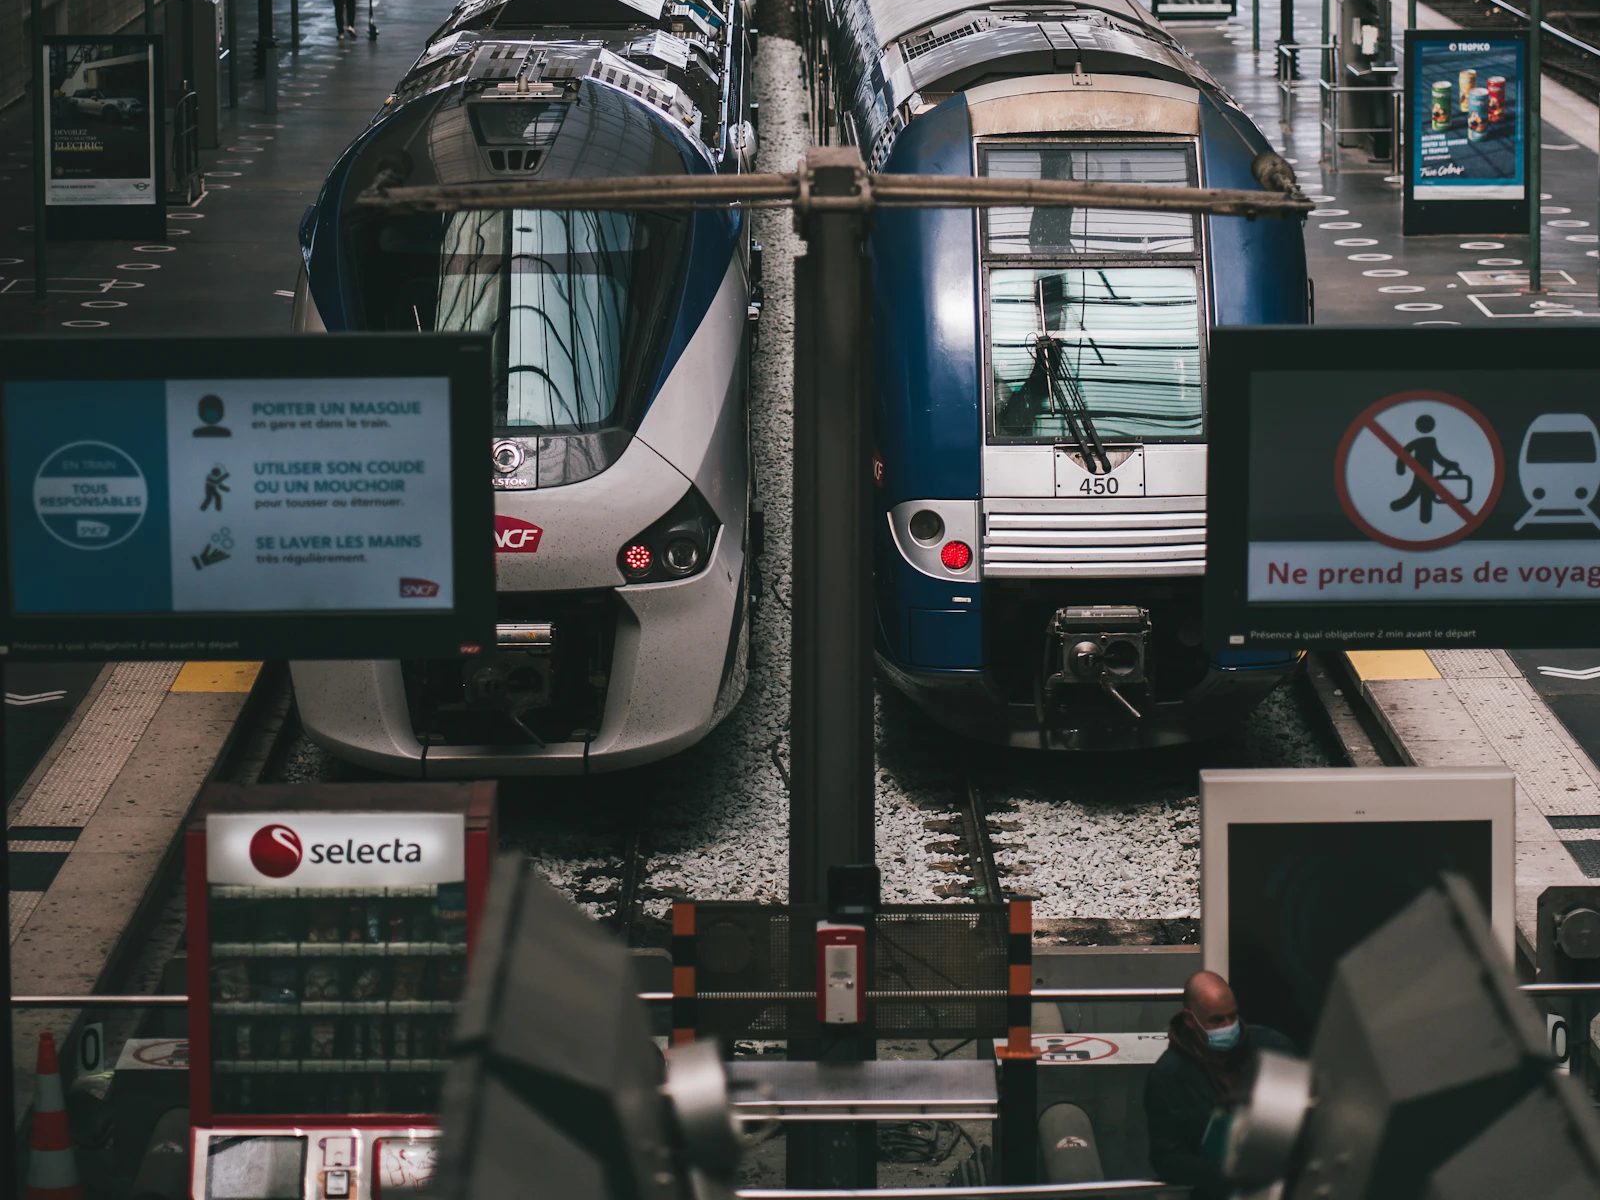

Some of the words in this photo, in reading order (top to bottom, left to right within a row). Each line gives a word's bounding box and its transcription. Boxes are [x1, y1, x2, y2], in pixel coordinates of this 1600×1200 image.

[1458, 43, 1490, 51] TROPICO
[251, 402, 315, 415] PORTER
[320, 402, 345, 415] UN
[350, 401, 422, 415] MASQUE
[251, 420, 266, 429] en
[269, 420, 296, 432] gare
[300, 418, 312, 429] et
[315, 418, 343, 429] dans
[346, 417, 357, 428] le
[360, 417, 391, 428] train.
[61, 460, 79, 470] EN
[253, 462, 323, 475] UTILISER
[326, 461, 363, 474] SON
[366, 460, 425, 474] COUDE
[71, 484, 108, 494] TOUS
[254, 480, 280, 493] OU
[284, 480, 309, 493] UN
[314, 479, 406, 493] MOUCHOIR
[492, 478, 527, 486] LSTOM
[1079, 477, 1119, 494] 450
[40, 496, 142, 507] RESPONSABLES
[254, 499, 282, 510] pour
[286, 498, 328, 508] tousser
[331, 499, 347, 507] ou
[256, 536, 275, 549] SE
[279, 536, 332, 549] LAVER
[336, 536, 364, 548] LES
[368, 535, 422, 548] MAINS
[494, 529, 538, 548] NCF
[256, 553, 279, 564] très
[1267, 562, 1308, 585] Ne
[1318, 561, 1403, 590] prend
[1414, 566, 1464, 589] pas
[1472, 561, 1508, 584] de
[1518, 565, 1600, 589] voyag
[402, 584, 437, 596] SNCF
[1250, 629, 1293, 639] Présence
[1295, 630, 1300, 639] à
[1302, 630, 1323, 641] quai
[1325, 629, 1375, 641] obligatoire
[1377, 629, 1384, 638] 2
[1386, 629, 1404, 638] min
[1406, 630, 1432, 638] avant
[1434, 629, 1443, 638] le
[1445, 629, 1476, 640] départ
[308, 839, 422, 864] selecta
[82, 1028, 100, 1071] 0
